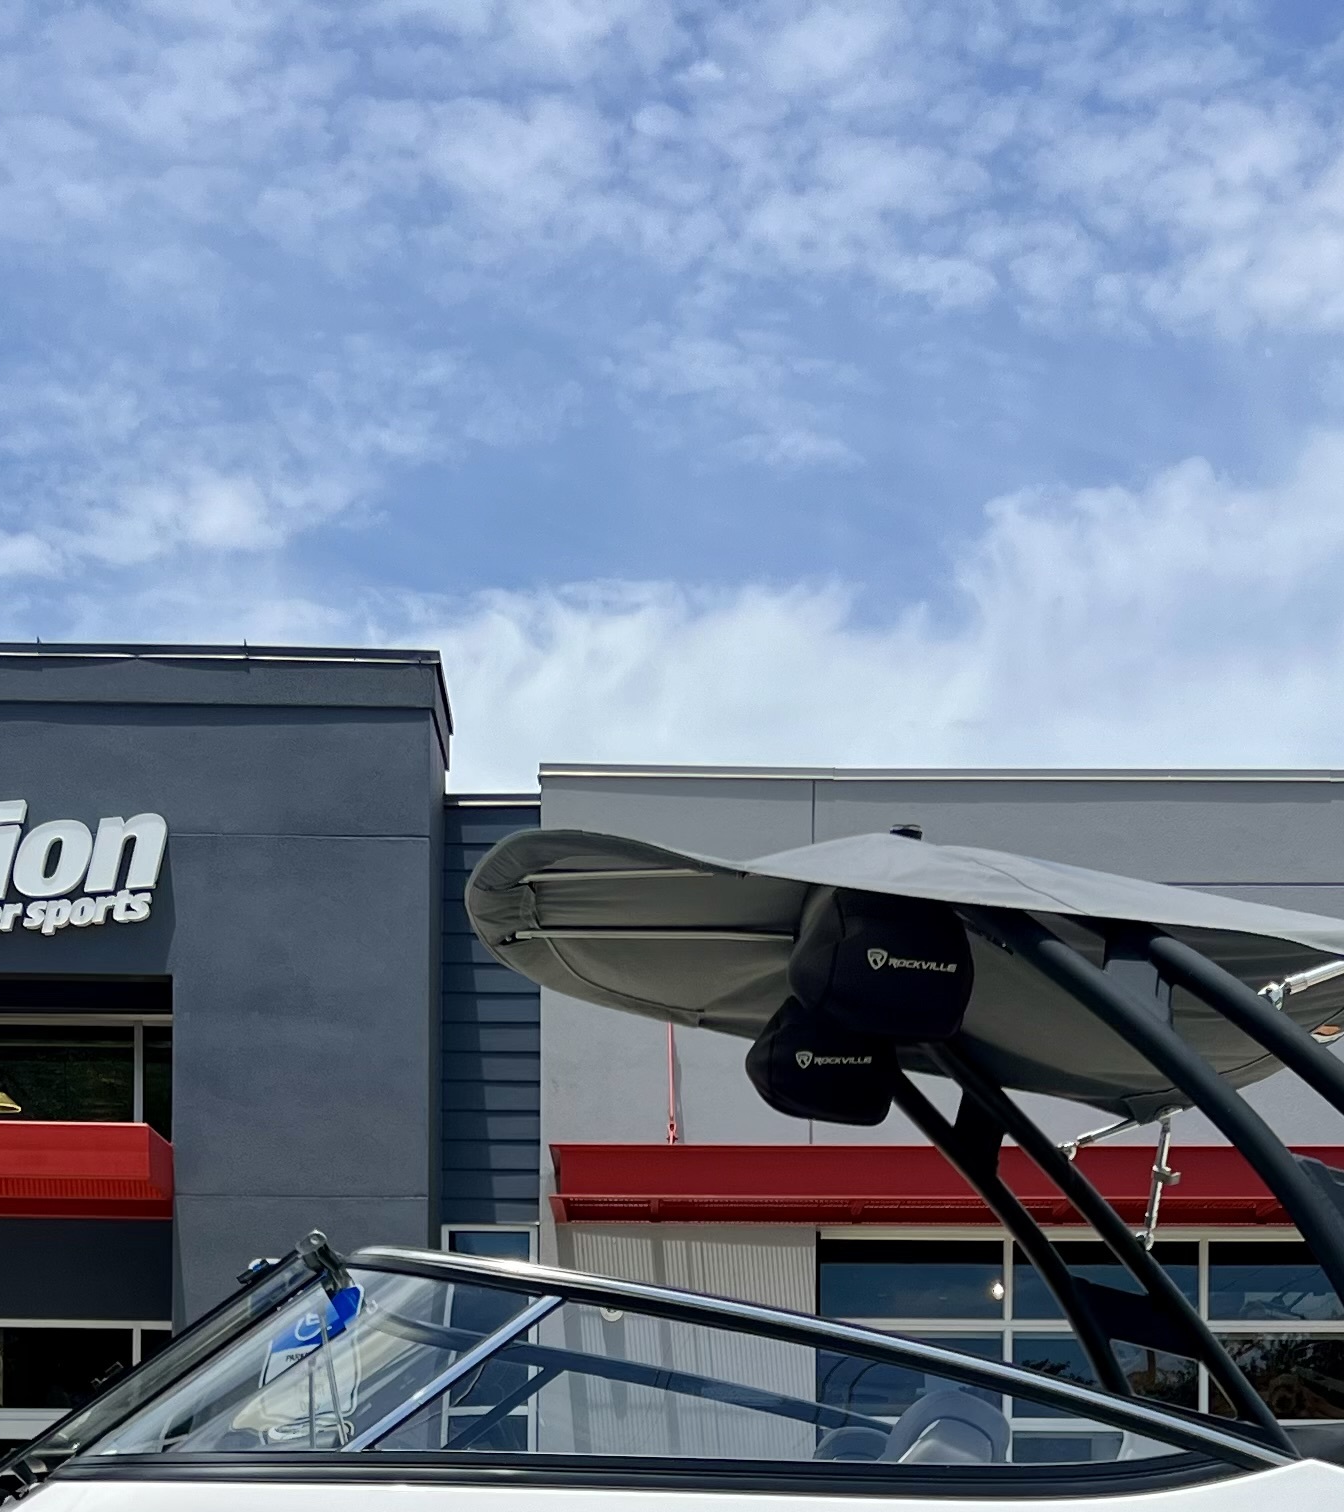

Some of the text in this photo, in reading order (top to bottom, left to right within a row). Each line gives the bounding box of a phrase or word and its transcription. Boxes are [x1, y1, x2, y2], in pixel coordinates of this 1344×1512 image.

[22, 889, 153, 936] sports
[887, 957, 958, 973] ROCKVILLE
[813, 1055, 873, 1066] ROCKVILLE
